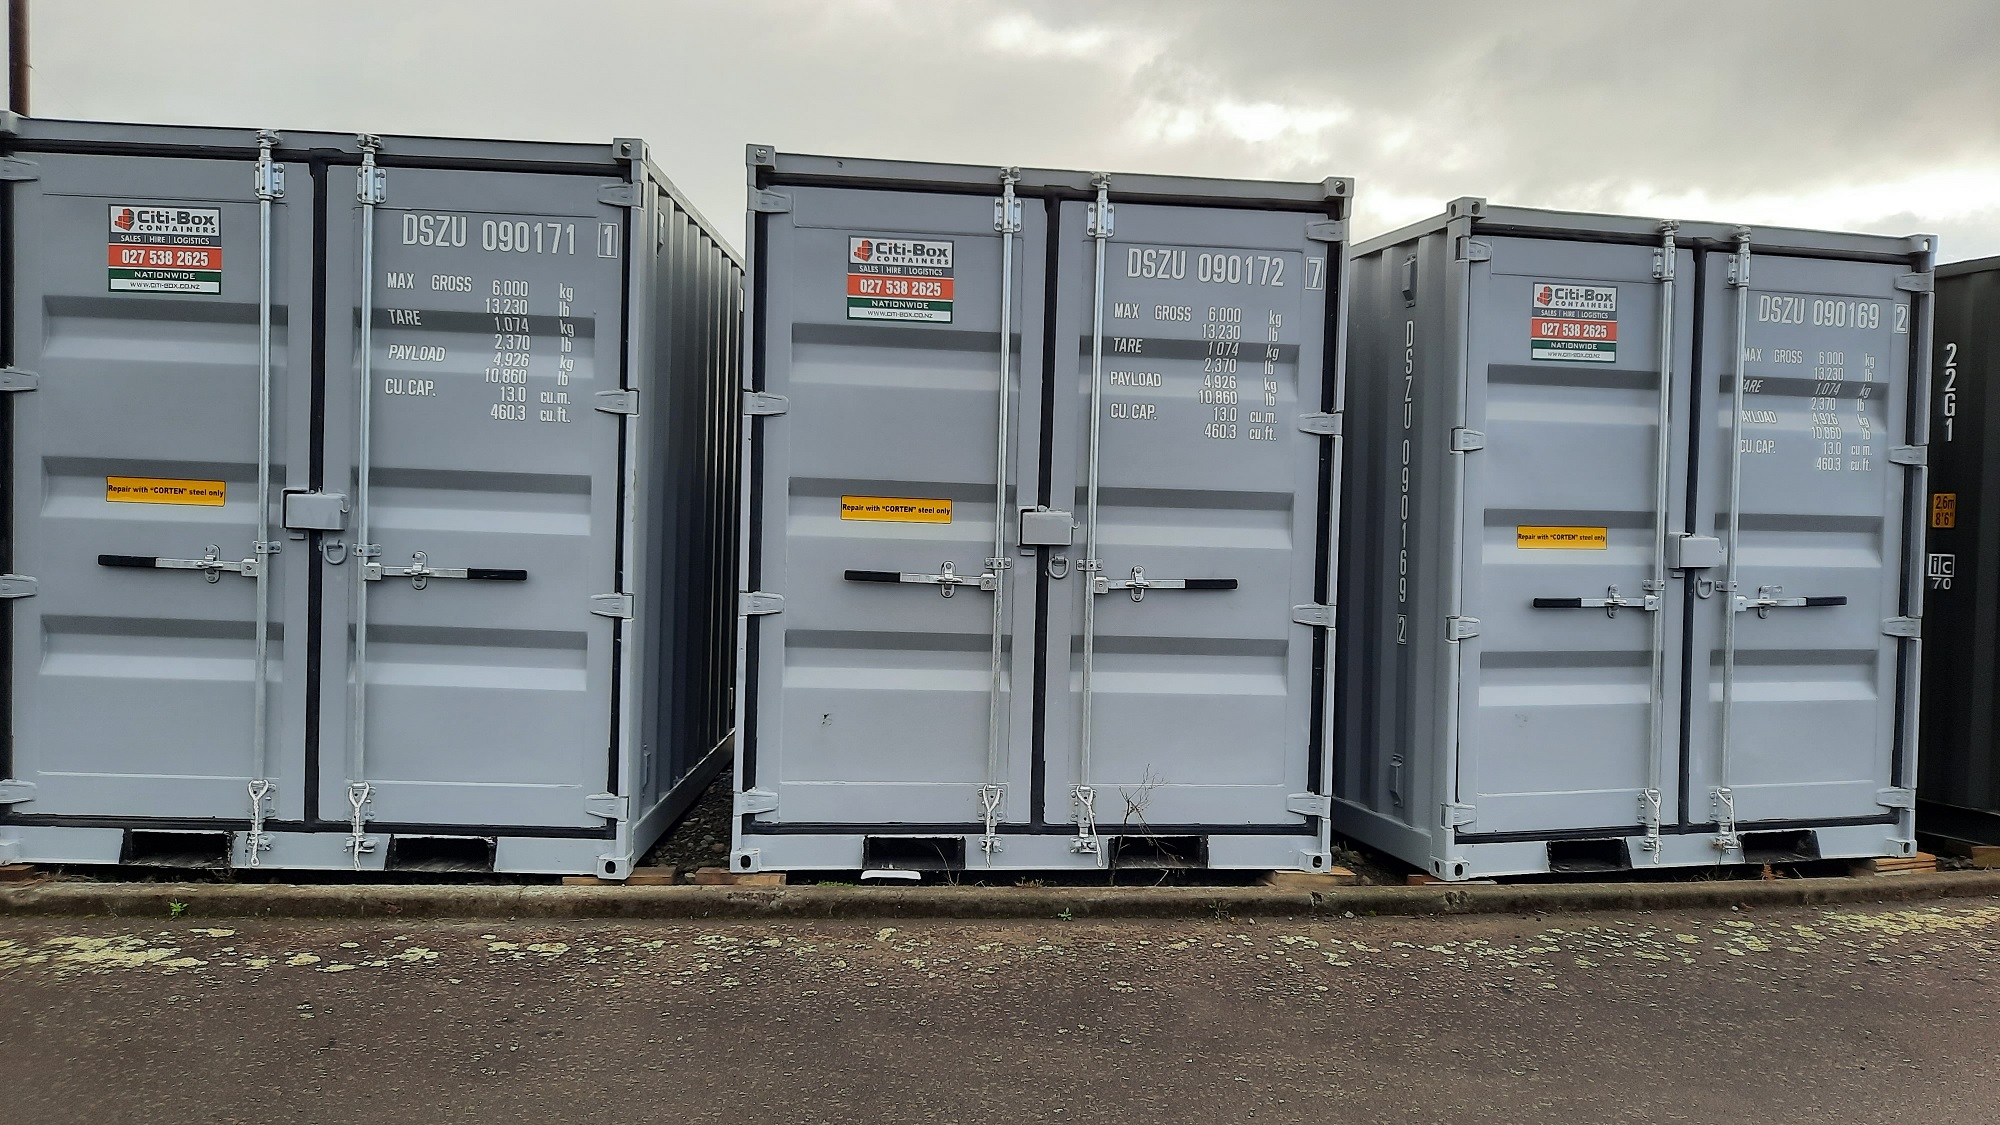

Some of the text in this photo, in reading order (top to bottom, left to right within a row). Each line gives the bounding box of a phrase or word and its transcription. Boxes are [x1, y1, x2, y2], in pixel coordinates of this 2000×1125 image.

[138, 210, 214, 225] Citi-Box
[139, 225, 216, 233] CONTAINERS
[402, 214, 467, 247] DSZU
[482, 221, 575, 255] 090171
[173, 237, 210, 245] LOGISTICS
[876, 242, 948, 258] Citi-Box
[122, 250, 208, 266] 027 538 2625
[877, 256, 949, 265] CONTAINERS
[859, 265, 879, 273] SALES
[909, 268, 943, 276] LOGISTICS
[1127, 248, 1186, 280] DSZU
[1197, 254, 1284, 287] 090172
[134, 271, 195, 280] NATIONWIDE
[387, 273, 415, 289] MAX
[432, 275, 472, 292] GROSS
[560, 283, 573, 301] kg
[860, 279, 941, 296] 027 538 2625
[1555, 288, 1612, 302] Citi-Box
[559, 302, 570, 317] lb
[872, 300, 929, 309] NATIONWIDE
[1555, 301, 1614, 309] CONTAINERS
[1759, 295, 1805, 325] DSZU
[1813, 300, 1880, 329] 090169
[1114, 303, 1140, 318] MAX
[1154, 304, 1192, 321] GROSS
[1269, 310, 1282, 327] kg
[388, 310, 422, 326] TARE
[560, 320, 575, 337] kg
[1541, 322, 1607, 338] 027 538 2625
[1268, 327, 1278, 341] lb
[561, 337, 572, 352] lb
[1114, 338, 1143, 353] TARE
[1266, 344, 1279, 360] kg
[1551, 342, 1597, 350] NATIONWIDE
[388, 345, 446, 361] PAYLOAD
[560, 355, 574, 371] kg
[1774, 350, 1802, 363] GROSS
[1865, 353, 1875, 368] kg
[1264, 360, 1274, 375] lb
[1403, 320, 1414, 430] DSZU
[1865, 368, 1872, 382] lb
[558, 371, 569, 385] lb
[1110, 371, 1162, 387] PAYLOAD
[1264, 377, 1277, 393] kg
[500, 386, 526, 402] 13.0
[1743, 380, 1763, 392] ARE
[1859, 384, 1871, 398] kg
[1943, 342, 1957, 442] 22G1
[1265, 393, 1275, 406] lb
[1857, 398, 1864, 411] lb
[491, 404, 526, 420] 460.3
[1213, 407, 1237, 422] 13.0
[1742, 410, 1777, 423] AYLOAD
[1857, 414, 1870, 428] kg
[1204, 424, 1236, 438] 460.3
[1862, 428, 1871, 440] lb
[1823, 442, 1841, 455] 13.0
[1816, 457, 1841, 471] 460.3
[108, 485, 131, 493] Repair
[209, 490, 224, 498] only
[843, 504, 864, 512] Repair
[1399, 439, 1410, 603] 090169
[1932, 578, 1951, 590] 70
